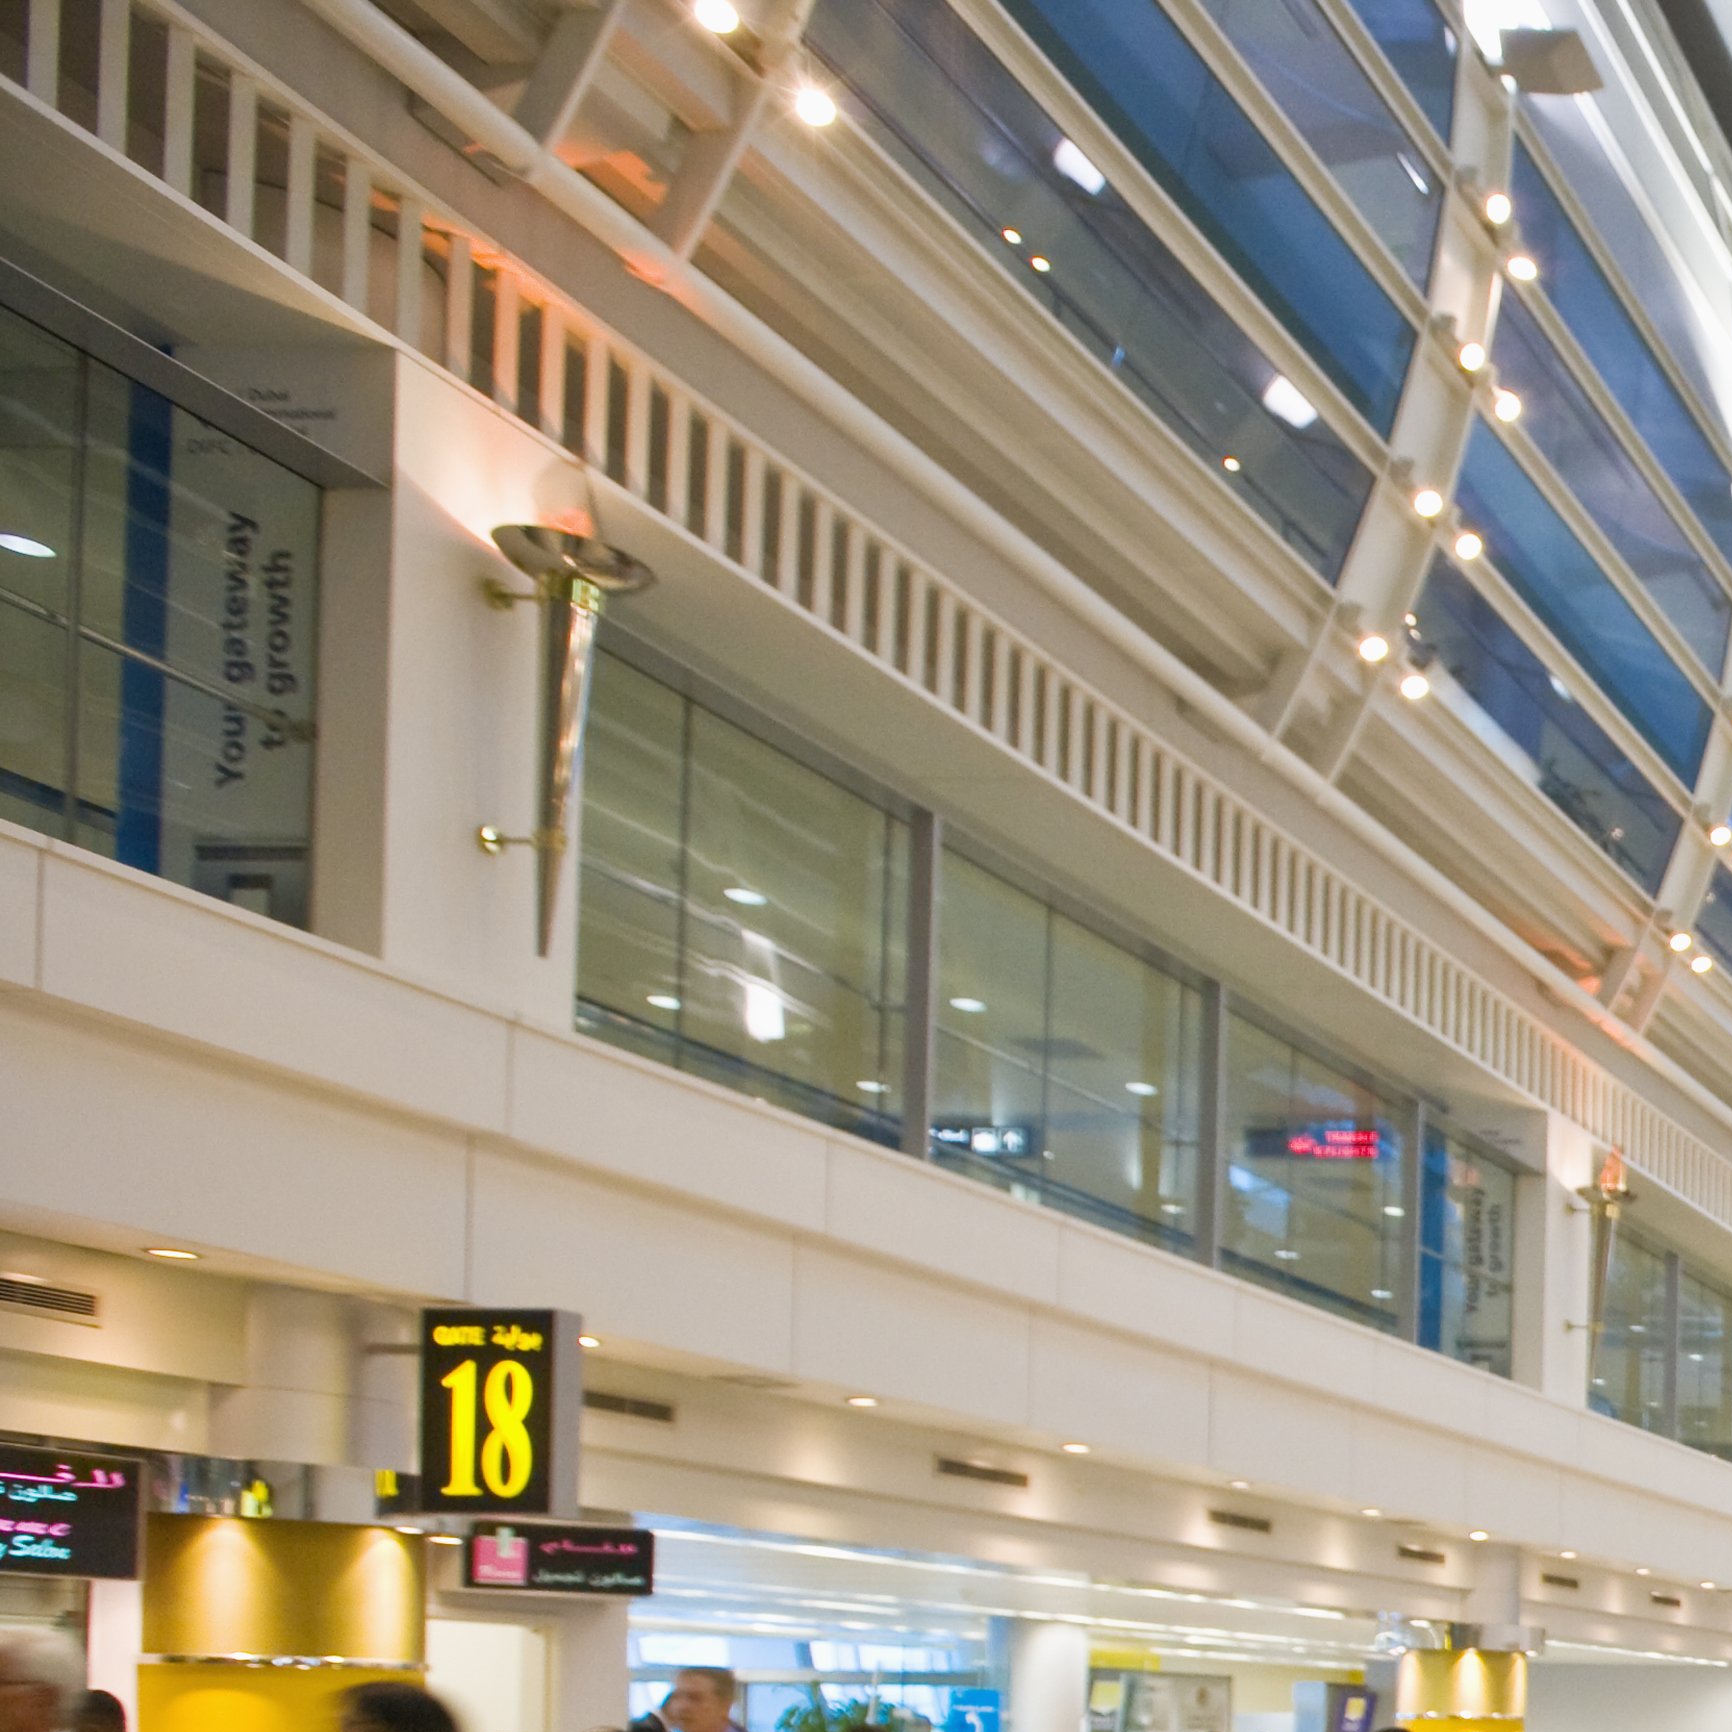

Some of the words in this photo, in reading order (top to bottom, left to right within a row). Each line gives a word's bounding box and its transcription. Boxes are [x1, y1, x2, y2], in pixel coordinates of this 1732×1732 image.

[222, 510, 260, 684] gateway
[261, 549, 298, 697] growth
[214, 703, 247, 789] Your
[432, 1325, 486, 1347] GATE
[440, 1358, 534, 1499] 18
